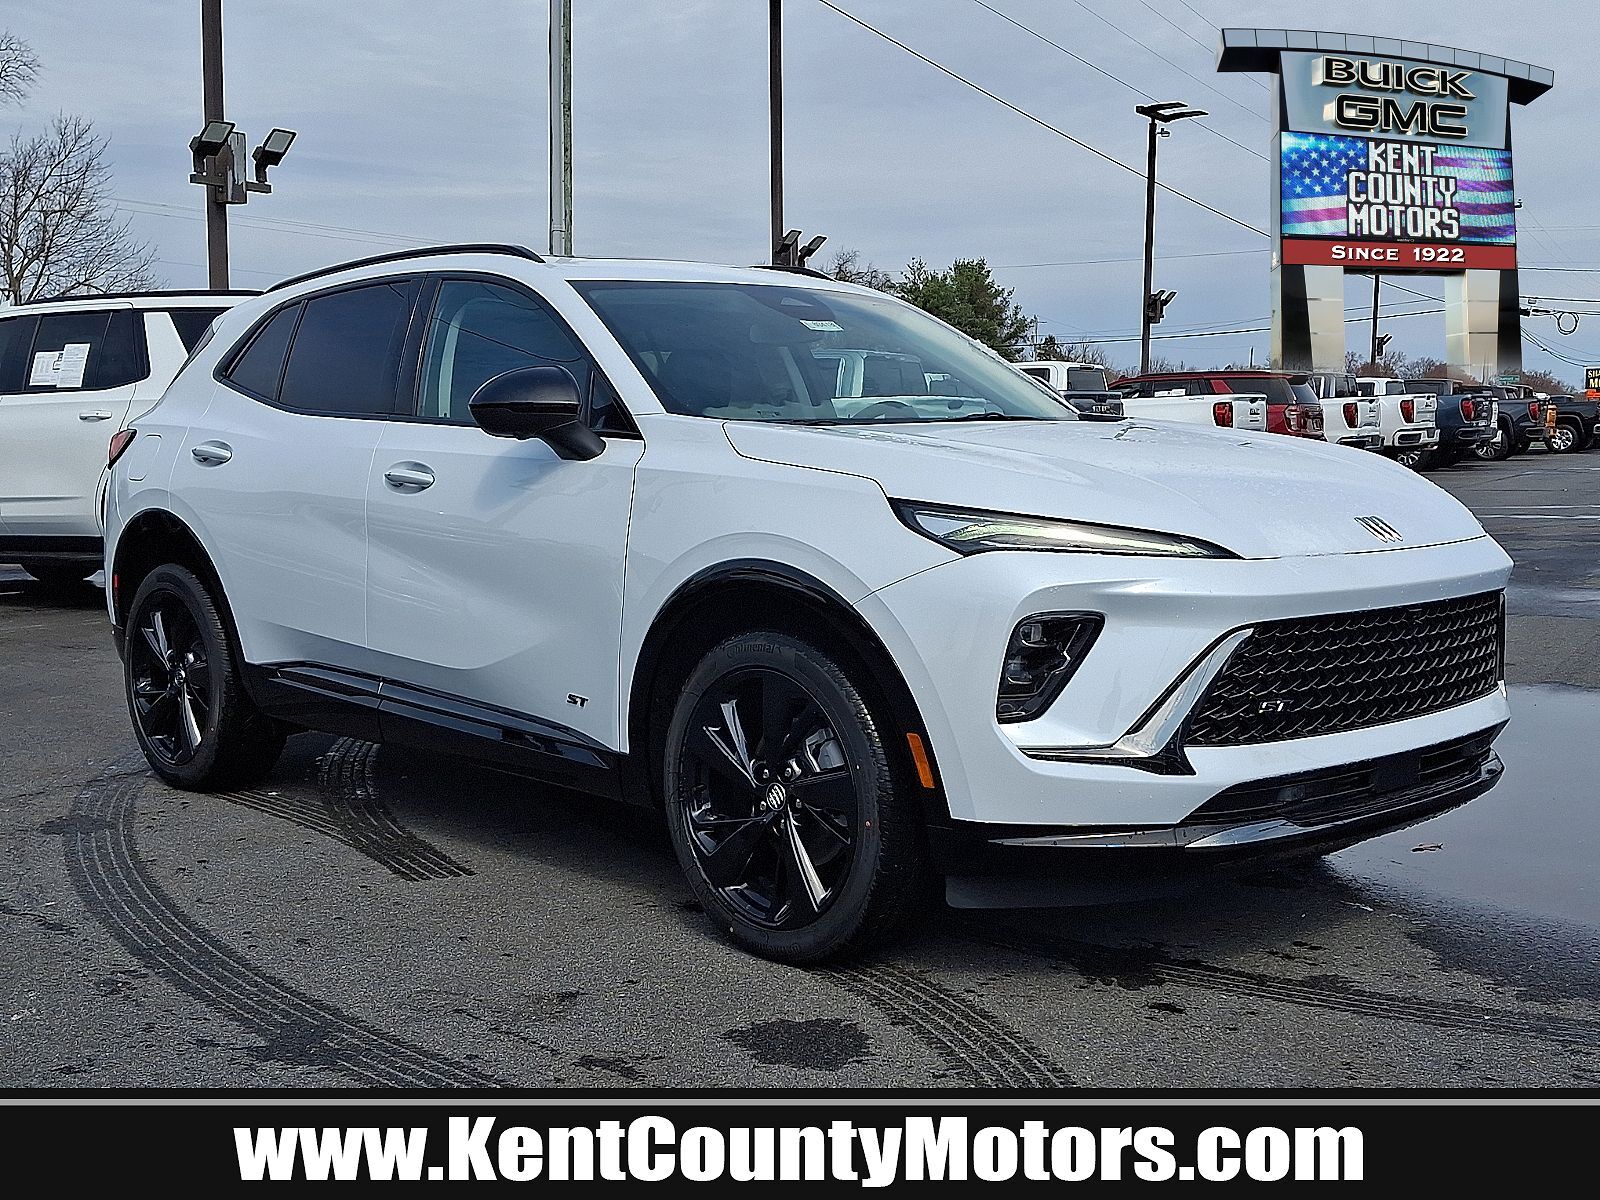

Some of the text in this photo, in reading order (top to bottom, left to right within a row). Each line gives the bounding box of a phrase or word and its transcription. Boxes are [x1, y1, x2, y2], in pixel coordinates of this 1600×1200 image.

[1322, 55, 1476, 98] BUICK
[1335, 93, 1468, 136] GMC
[1368, 141, 1436, 176] KENT
[1348, 171, 1456, 208] COUNTY
[1348, 203, 1459, 239] MOTORS
[1413, 247, 1465, 263] 1922
[566, 693, 590, 708] ST
